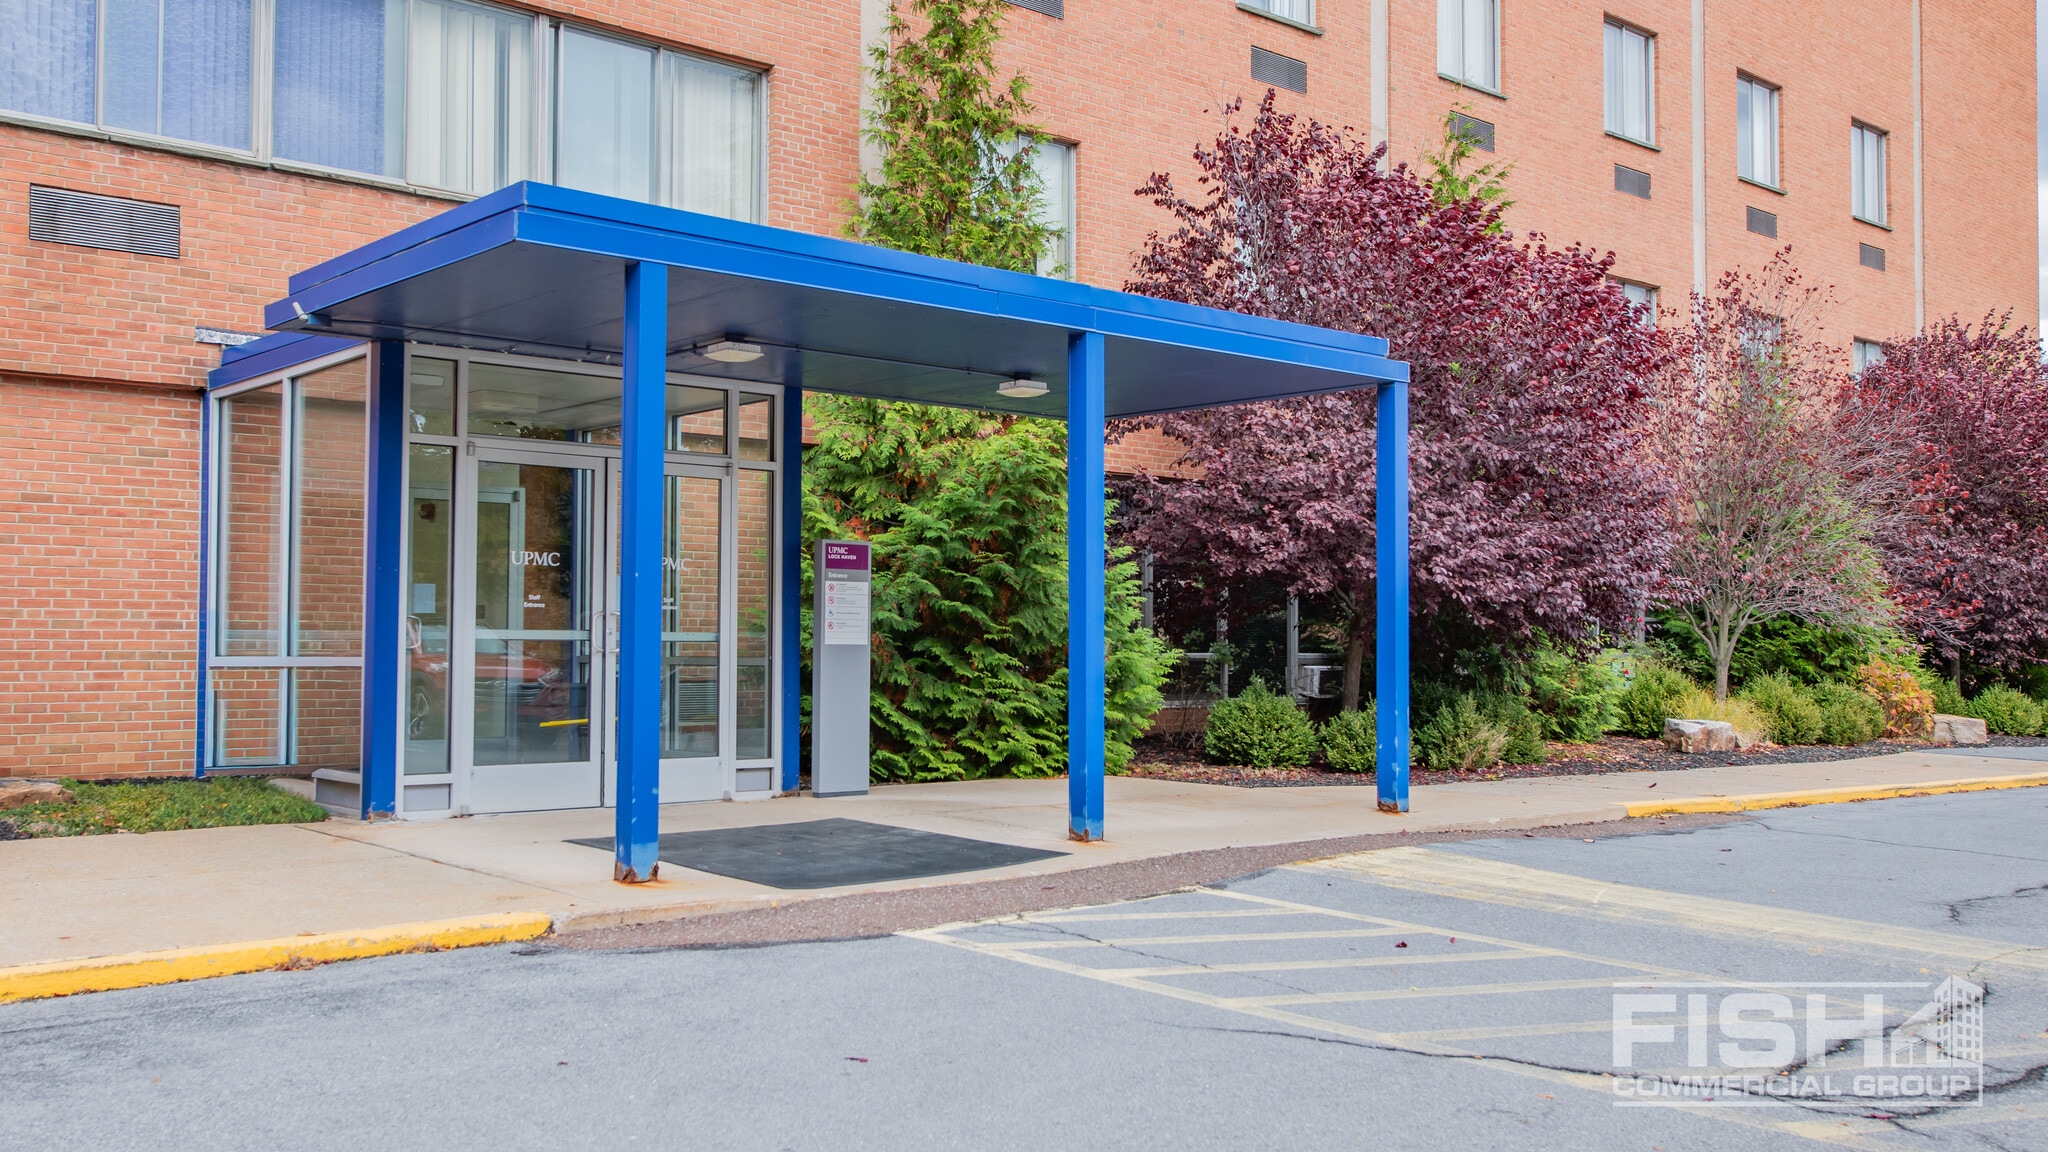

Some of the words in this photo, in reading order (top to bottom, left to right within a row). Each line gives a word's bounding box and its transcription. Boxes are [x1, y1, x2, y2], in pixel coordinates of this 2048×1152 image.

[828, 546, 848, 554] UPMC
[511, 550, 561, 567] UPMC
[661, 556, 692, 571] PMC
